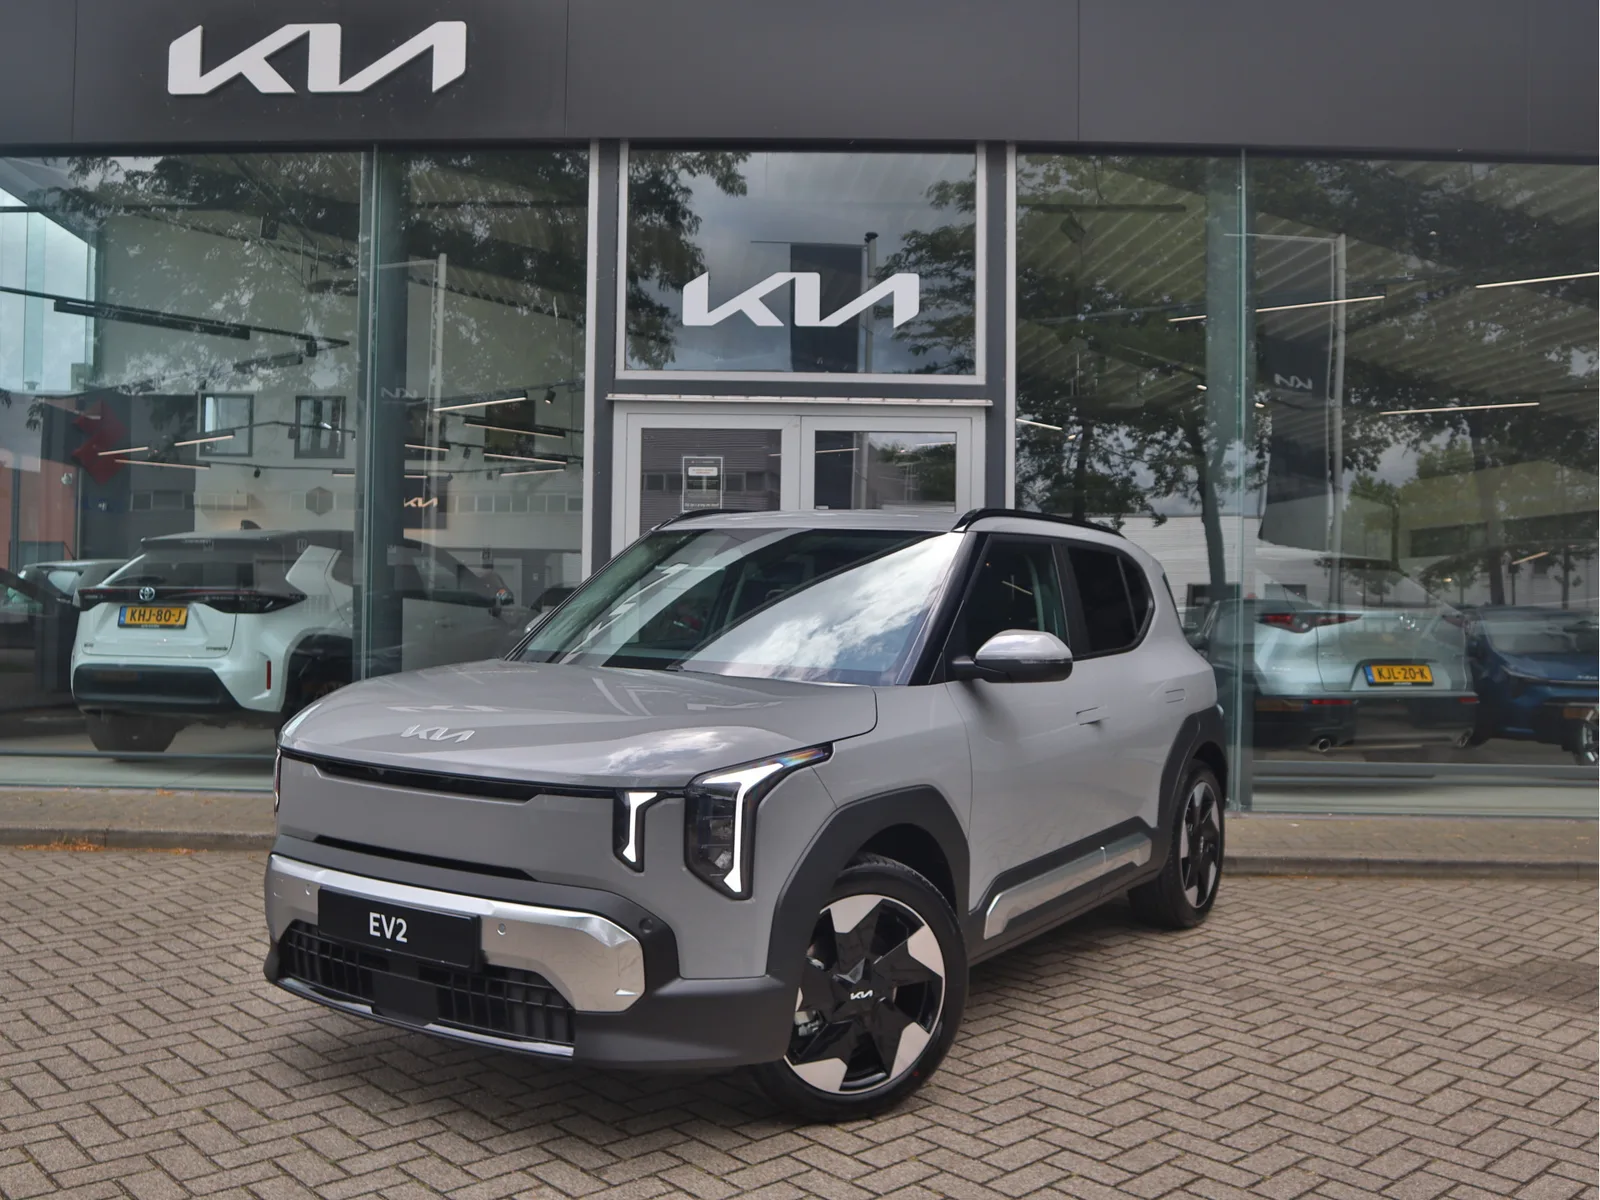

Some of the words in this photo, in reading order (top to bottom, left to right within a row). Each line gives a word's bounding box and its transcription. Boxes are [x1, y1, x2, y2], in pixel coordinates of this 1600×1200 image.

[167, 20, 467, 95] KIA
[683, 271, 920, 328] KIA
[129, 605, 183, 623] KHJ-80-J
[1376, 666, 1429, 681] KJL-20-K
[400, 724, 476, 743] KIA
[369, 911, 408, 943] EV2
[850, 989, 874, 1000] KIA
